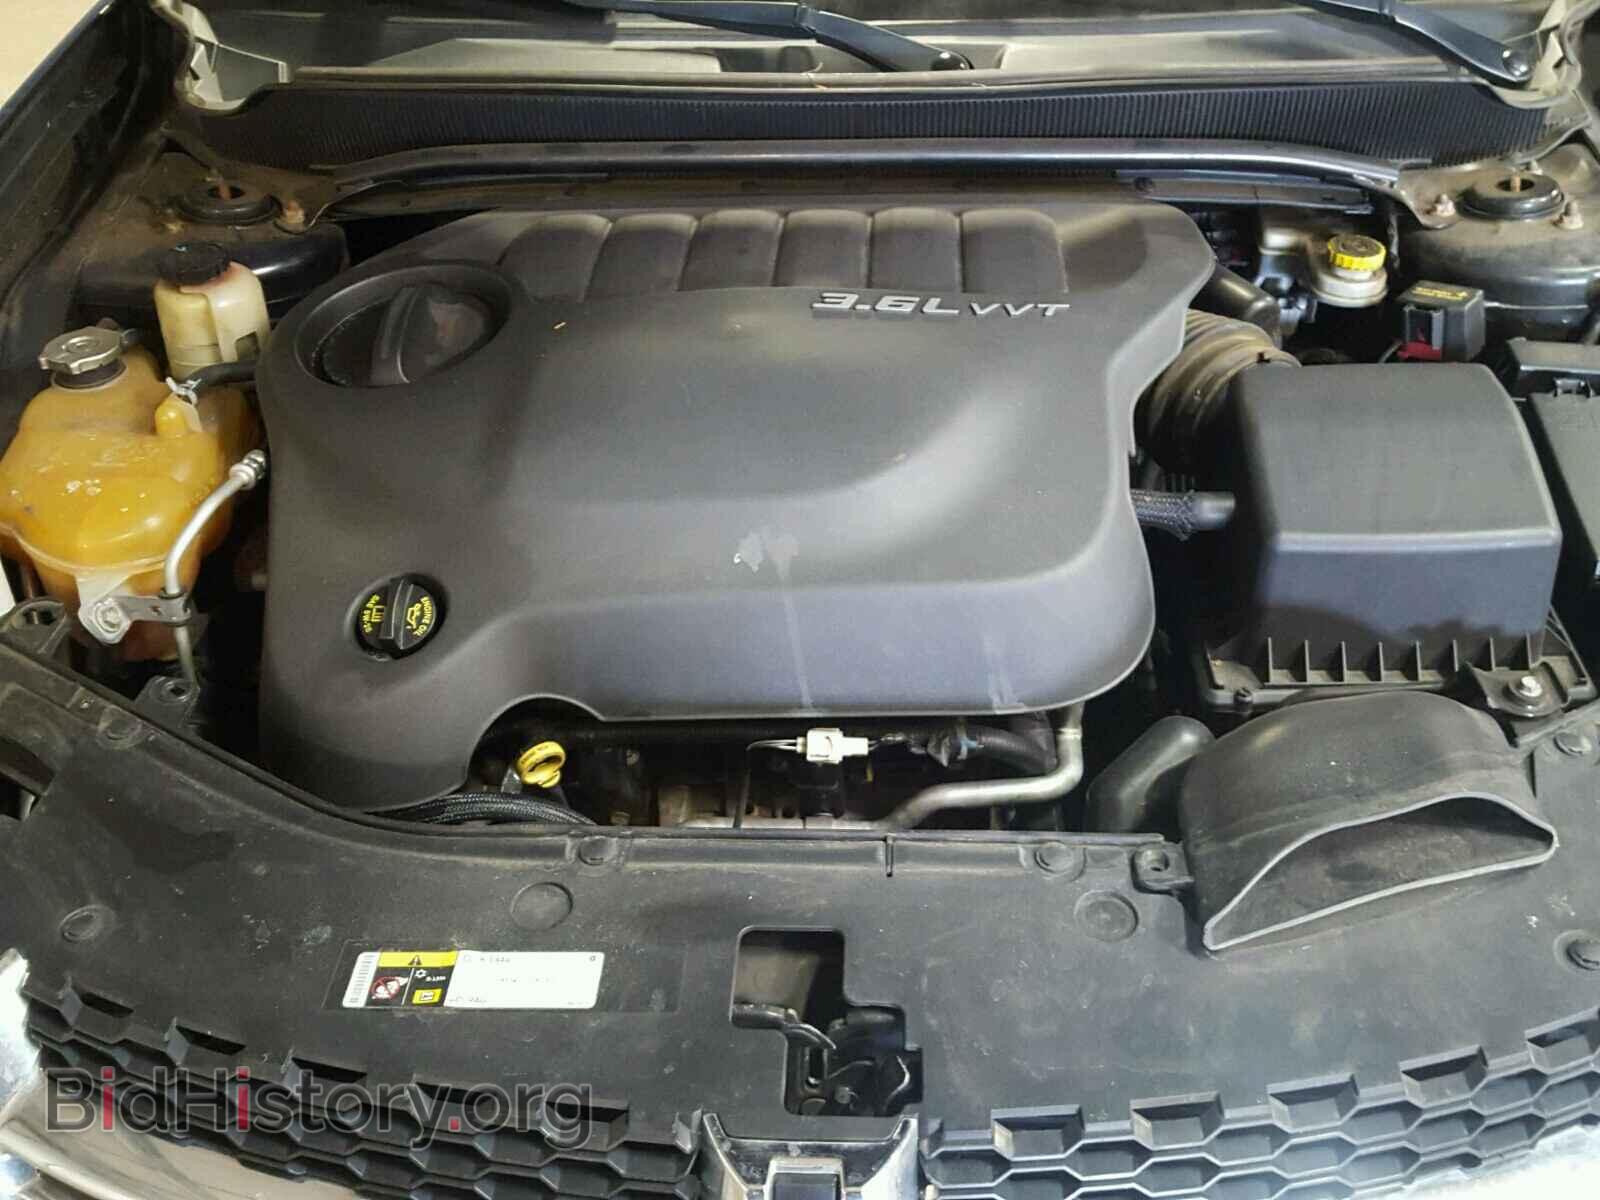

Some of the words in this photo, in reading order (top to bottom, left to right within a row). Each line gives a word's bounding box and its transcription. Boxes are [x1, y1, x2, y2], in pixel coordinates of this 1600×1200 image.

[812, 292, 960, 315] 3.6L
[969, 302, 1070, 317] VVT
[420, 596, 433, 625] ENGINE
[412, 624, 427, 637] OIL
